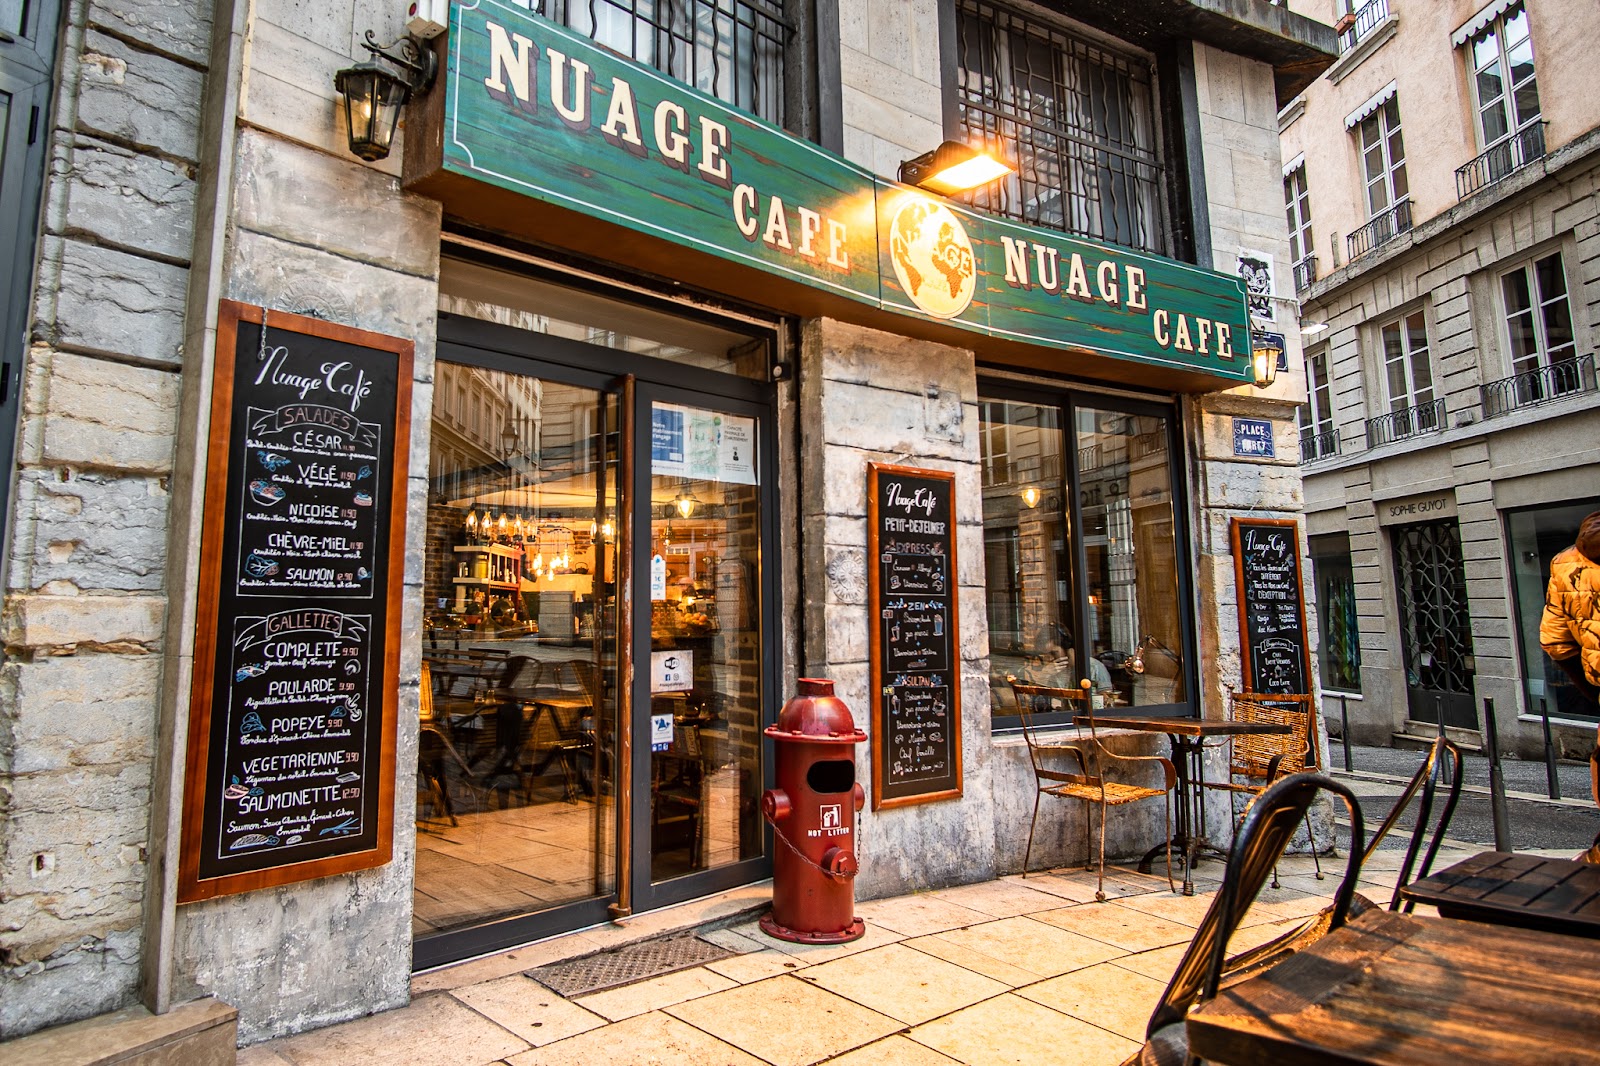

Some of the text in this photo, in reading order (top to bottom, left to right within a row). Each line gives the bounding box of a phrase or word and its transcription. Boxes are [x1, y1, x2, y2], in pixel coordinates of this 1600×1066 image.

[484, 20, 731, 187] NUAGE
[732, 183, 852, 273] CAFE
[1000, 235, 1149, 313] NUAGE
[1153, 308, 1234, 360] CAFE
[254, 346, 373, 413] Nuage Café
[284, 407, 350, 430] SALADES
[1240, 424, 1265, 436] PLACE
[293, 430, 342, 450] CÉSAR
[298, 462, 357, 481] VÉGÉ 11.90
[914, 487, 937, 517] Café
[1389, 498, 1447, 517] SOPHIE GUYOT
[341, 509, 357, 519] 11.90
[350, 541, 364, 550] 11.90
[896, 542, 931, 555] EXPRESS
[285, 567, 335, 581] SAUMON
[907, 602, 926, 611] ZEN
[268, 613, 342, 633] GALLETTES
[263, 641, 359, 659] COMPLETE 9.90
[268, 678, 337, 696] POULARDE
[906, 676, 931, 687] SULTAN
[271, 715, 326, 734] POPEYE
[238, 784, 360, 815] SAUMONETTE 12.90
[807, 829, 822, 837] NOT
